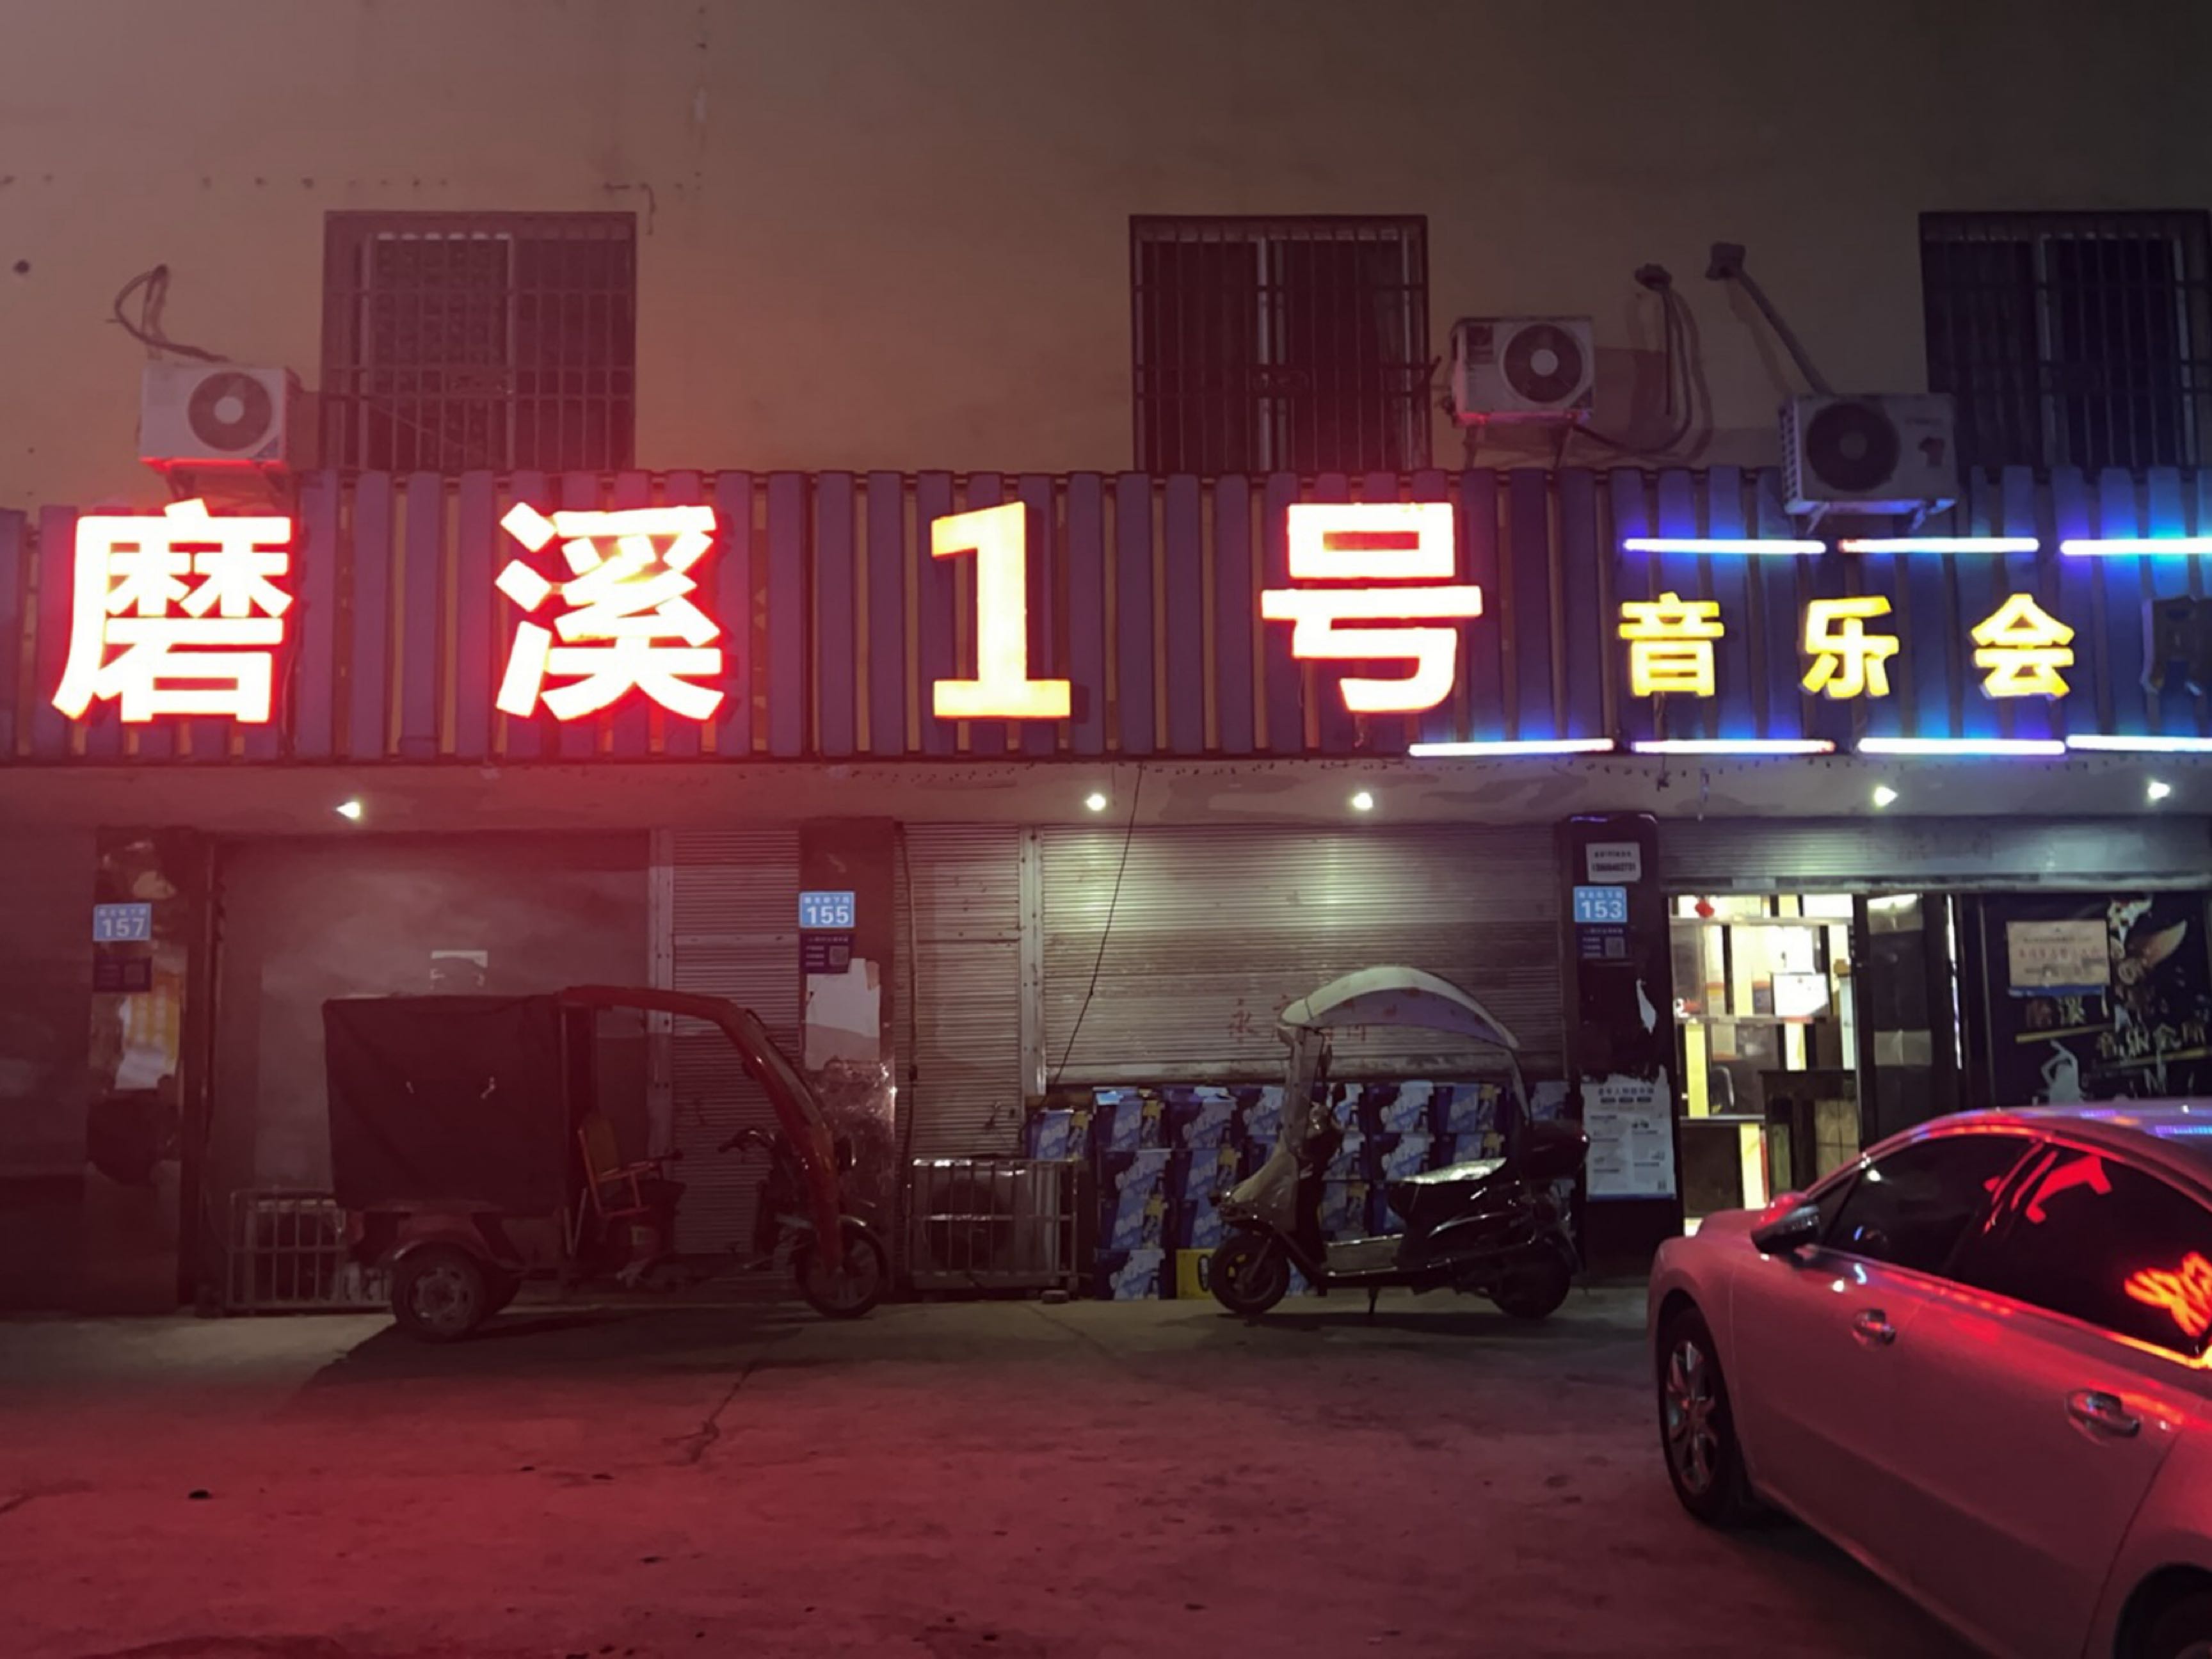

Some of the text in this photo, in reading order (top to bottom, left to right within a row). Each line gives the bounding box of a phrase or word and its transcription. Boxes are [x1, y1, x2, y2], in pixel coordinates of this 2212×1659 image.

[52, 498, 1484, 724] 磨溪1号
[1618, 592, 2076, 699] 音乐会
[806, 906, 849, 924] 155
[1581, 900, 1623, 918] 153
[102, 917, 145, 937] 157
